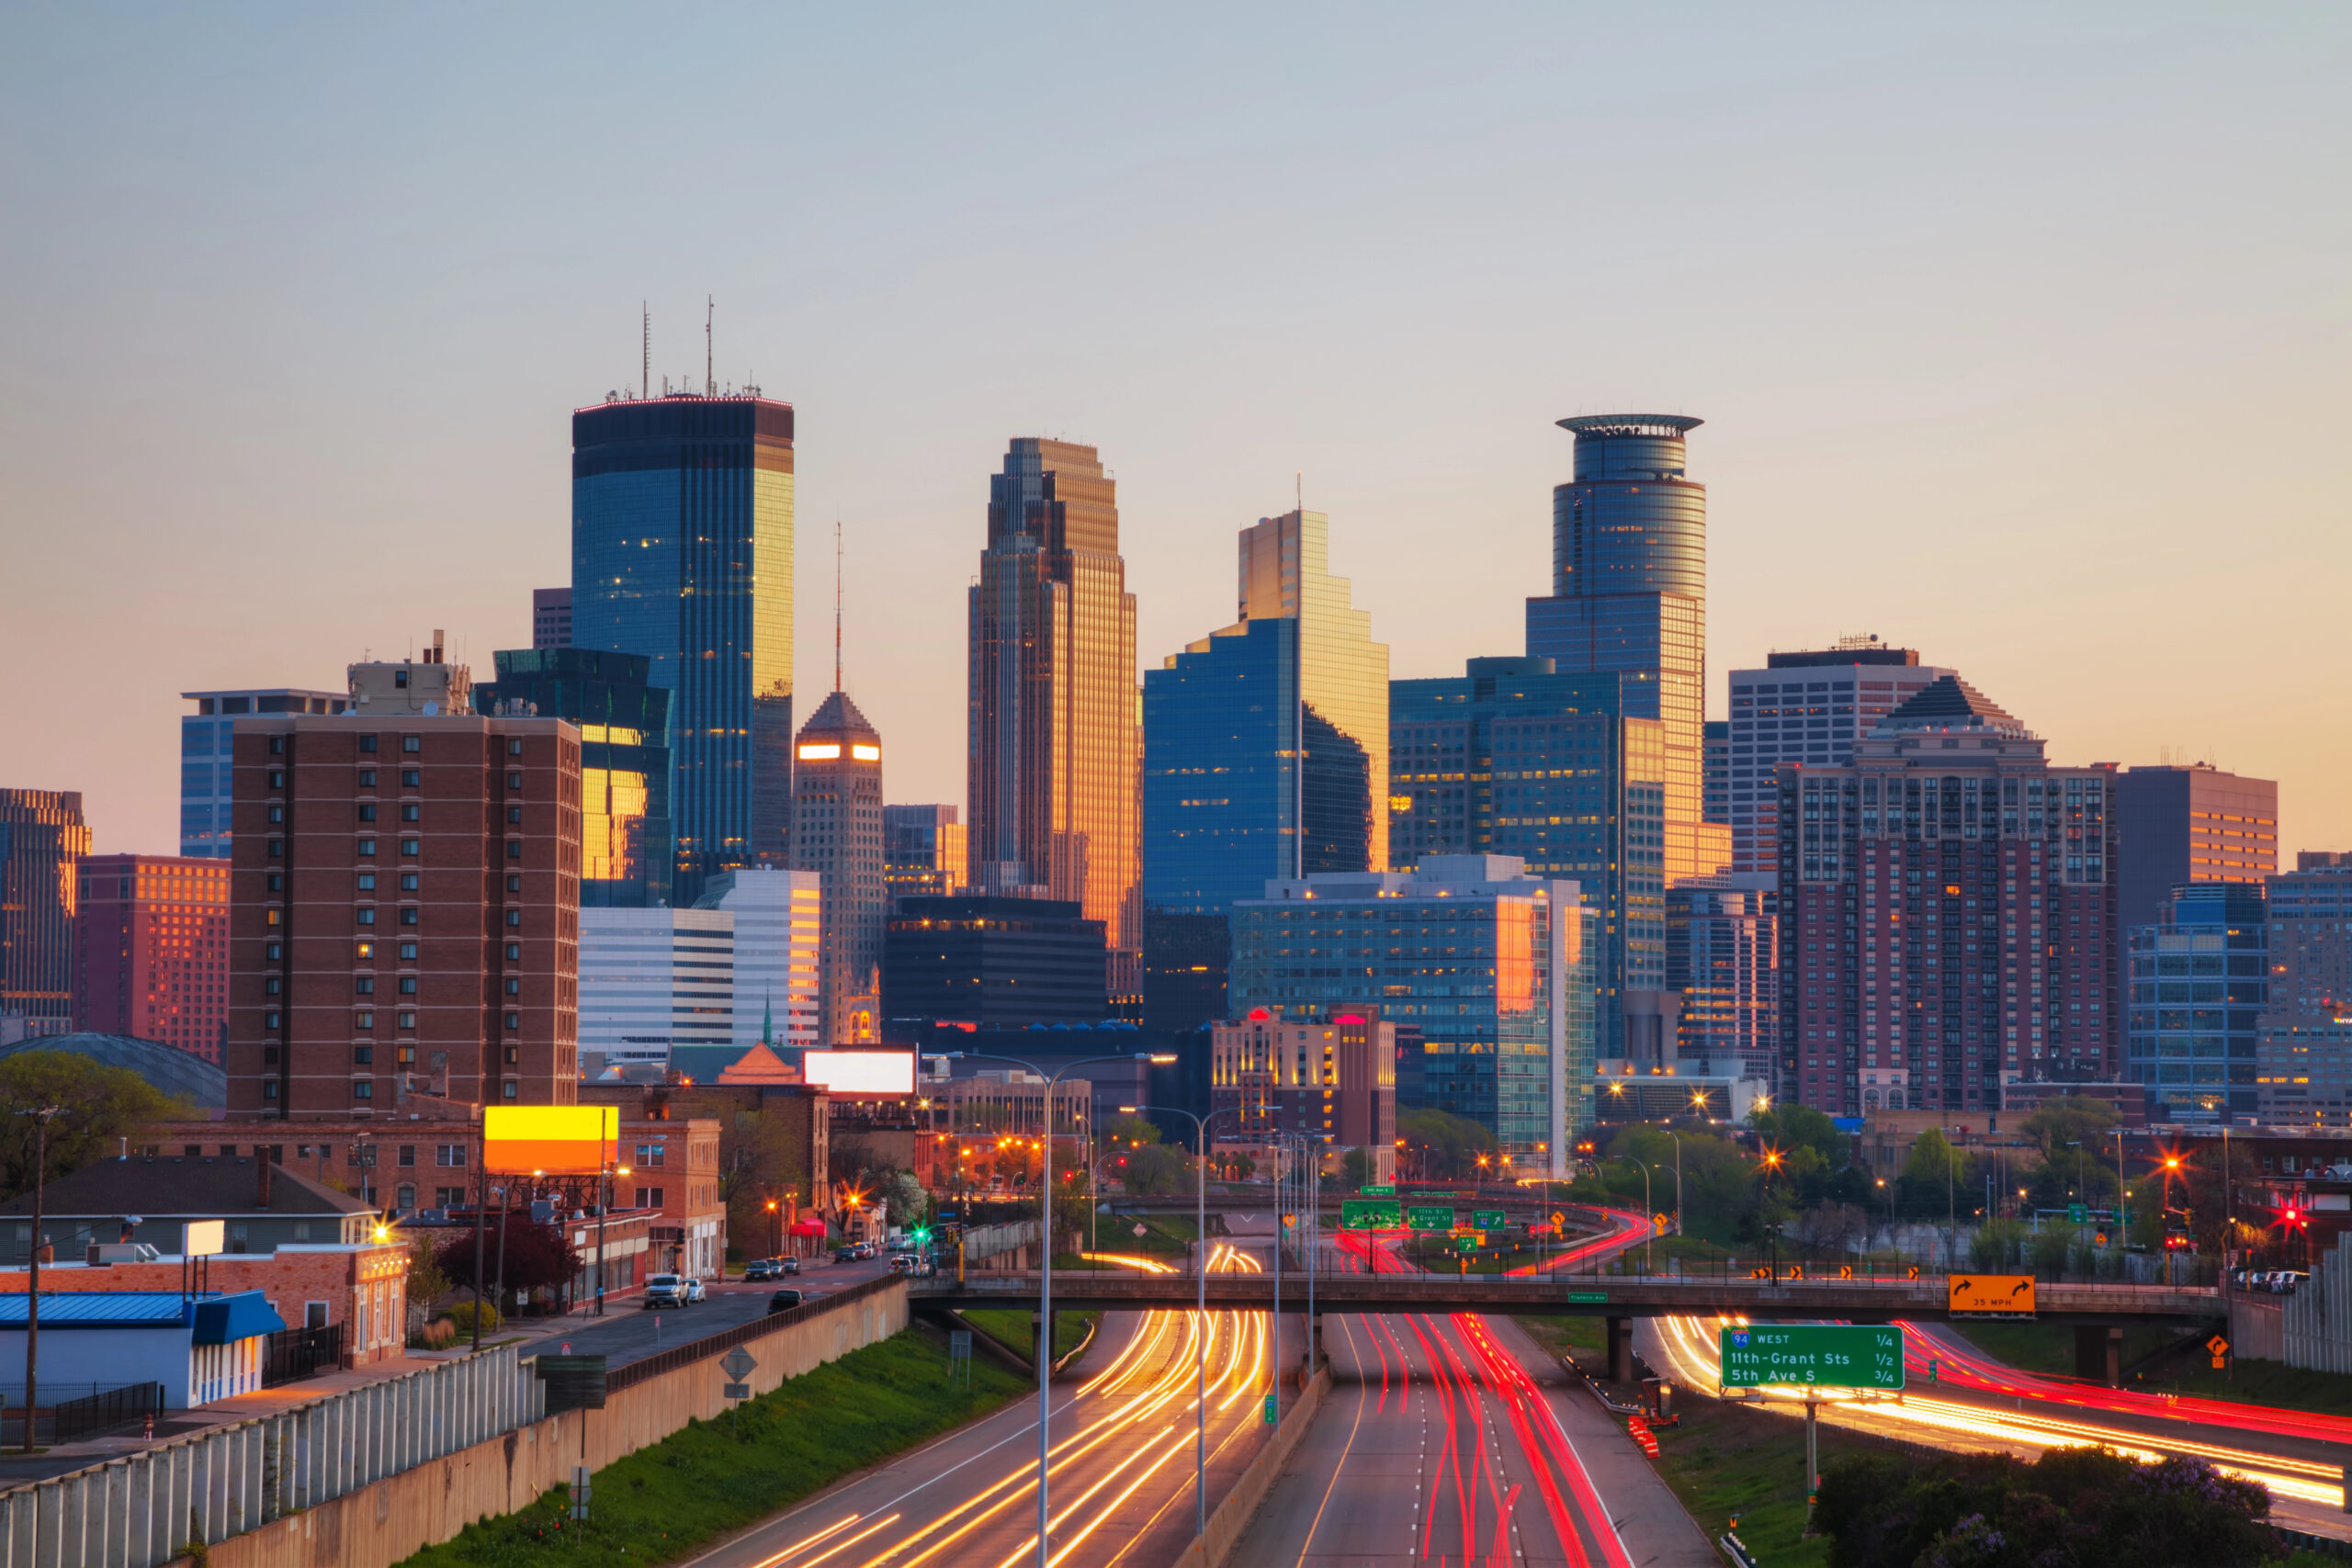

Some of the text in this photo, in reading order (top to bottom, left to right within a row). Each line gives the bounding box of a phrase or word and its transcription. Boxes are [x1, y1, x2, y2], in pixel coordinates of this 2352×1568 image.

[1973, 1298, 1985, 1306] 35
[1734, 1335, 1747, 1344] 94
[1757, 1335, 1790, 1344] WEST
[1731, 1352, 1815, 1365] 11th-Grant
[1825, 1353, 1850, 1365] Sts
[1732, 1370, 1758, 1382] 5th
[1768, 1370, 1797, 1382] Ave
[1806, 1370, 1815, 1382] S
